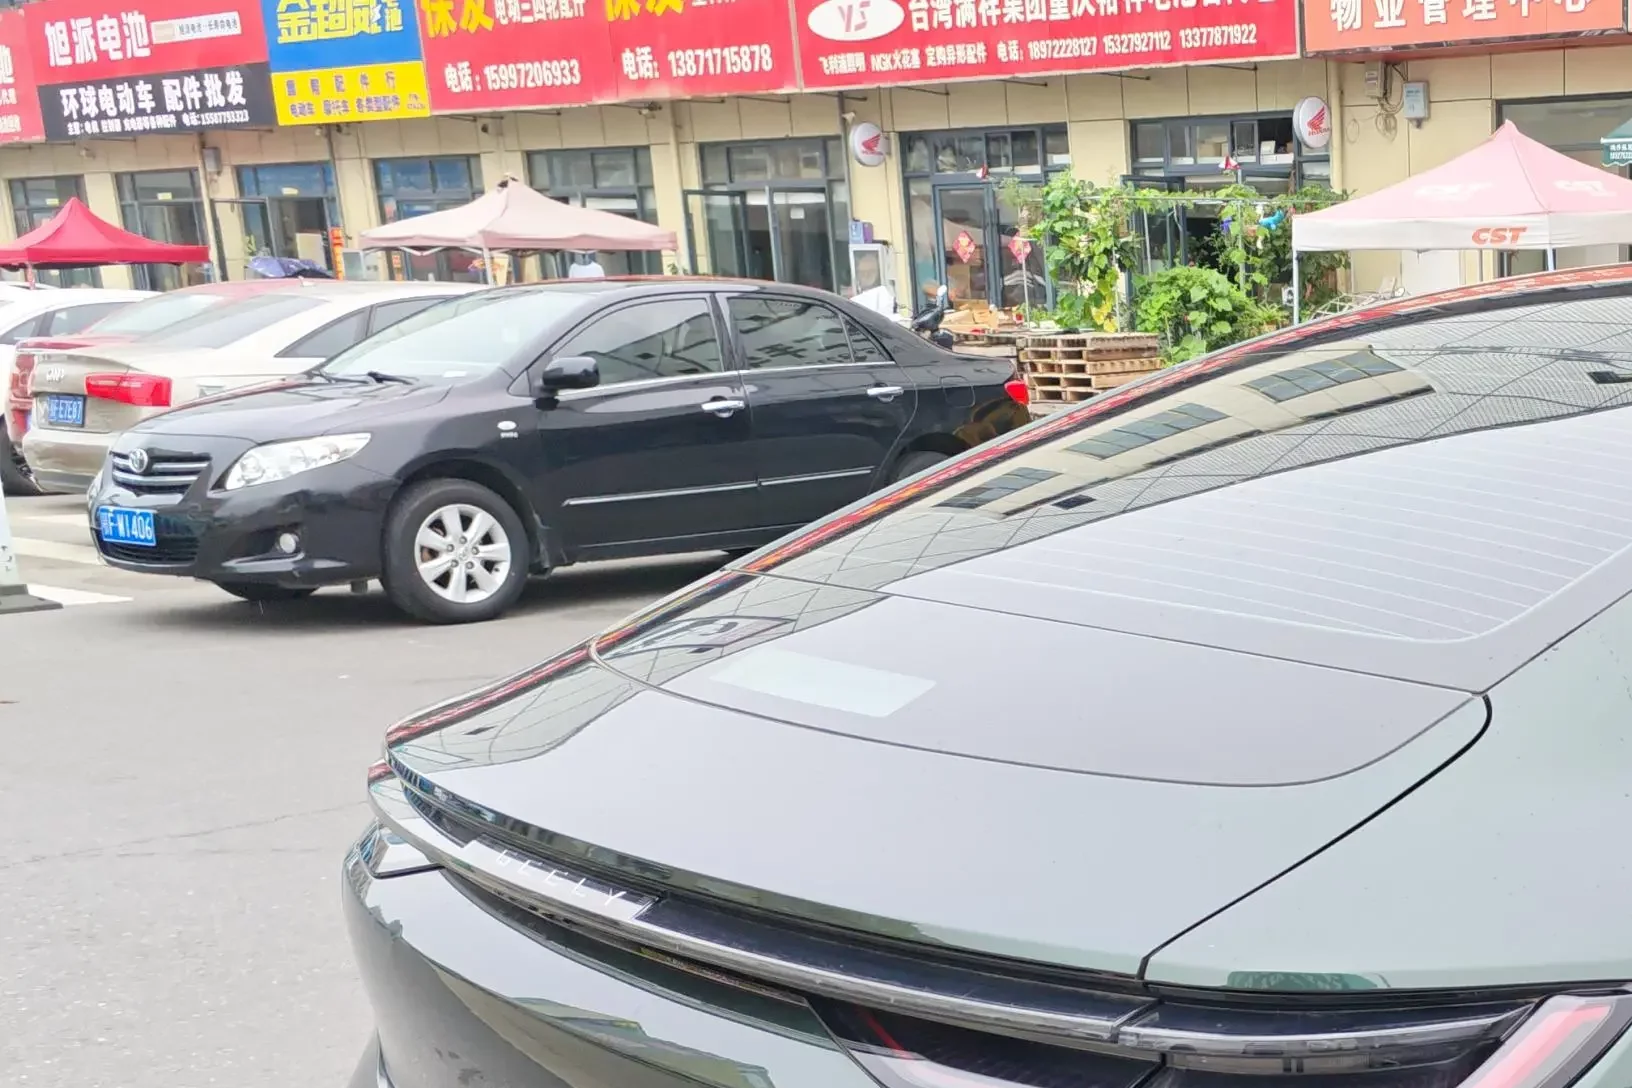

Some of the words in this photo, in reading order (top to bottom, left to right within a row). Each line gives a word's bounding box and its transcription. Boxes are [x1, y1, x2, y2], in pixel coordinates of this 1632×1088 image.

[45, 10, 151, 67] 旭派电池
[1103, 30, 1172, 55] 15327927112
[1179, 23, 1257, 49] 13377871922
[668, 44, 773, 77] 13871715878
[60, 81, 156, 120] 环球电动车
[162, 71, 247, 112] 配件批发
[1472, 227, 1528, 245] CST
